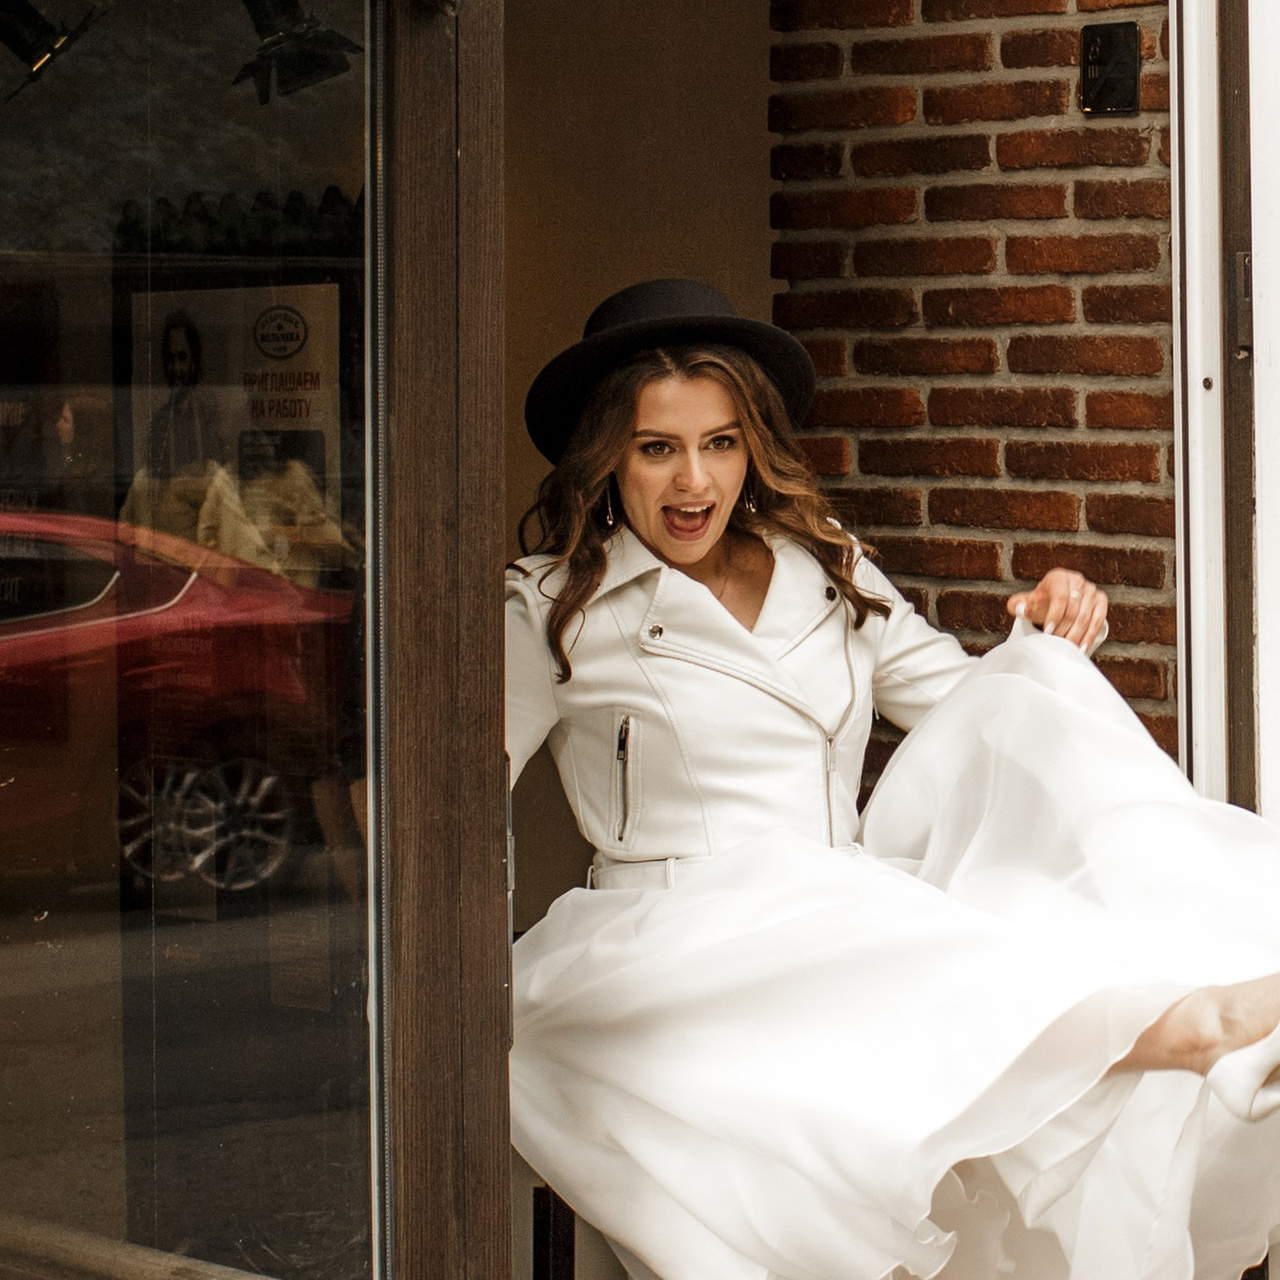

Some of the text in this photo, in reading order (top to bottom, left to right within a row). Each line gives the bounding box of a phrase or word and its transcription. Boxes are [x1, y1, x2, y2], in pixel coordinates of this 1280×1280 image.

[243, 372, 321, 392] ПРИГЛАШАЕМ
[251, 399, 312, 418] НА РАБОТУ
